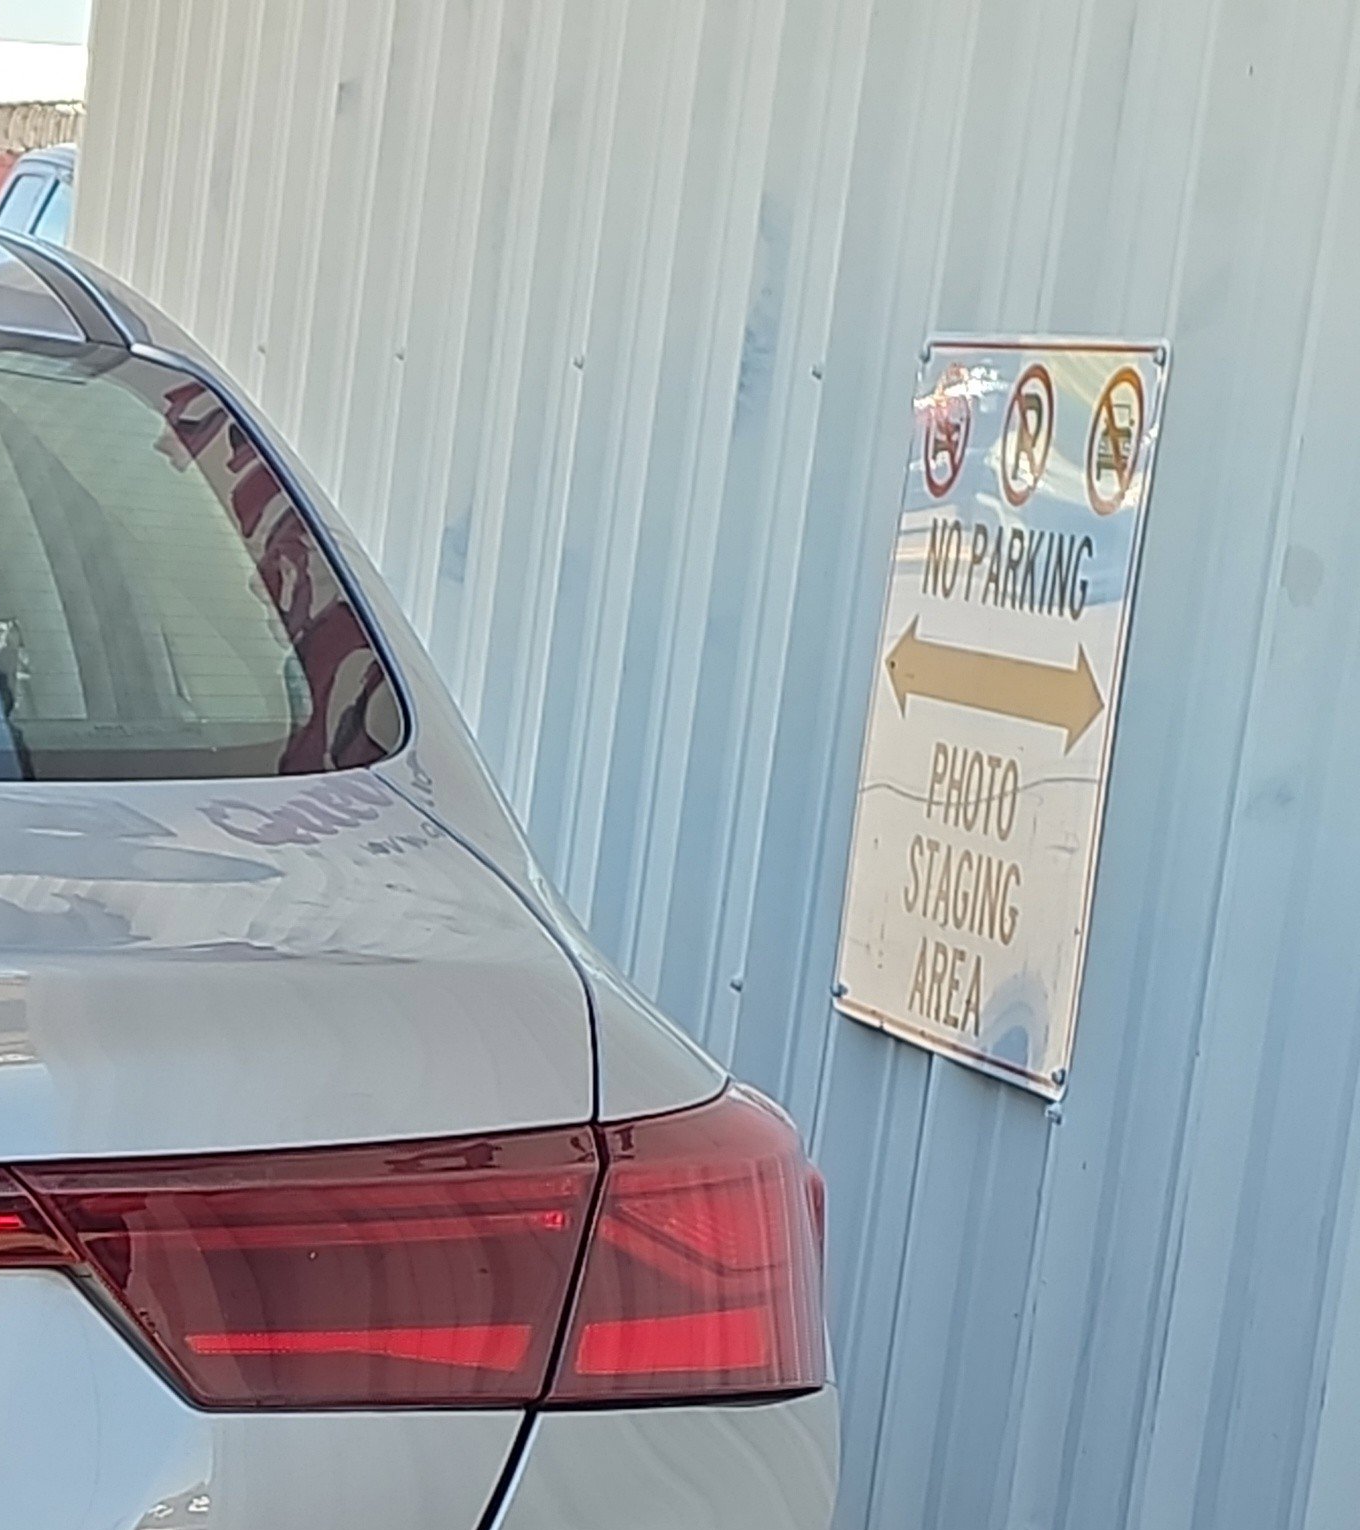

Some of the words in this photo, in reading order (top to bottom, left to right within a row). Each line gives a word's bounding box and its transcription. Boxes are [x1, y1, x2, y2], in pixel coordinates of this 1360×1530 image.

[922, 518, 960, 599] NO
[965, 525, 1093, 620] PARKING
[927, 742, 1019, 841] PHOTO
[902, 833, 1022, 946] STAGING
[907, 936, 982, 1037] AREA
